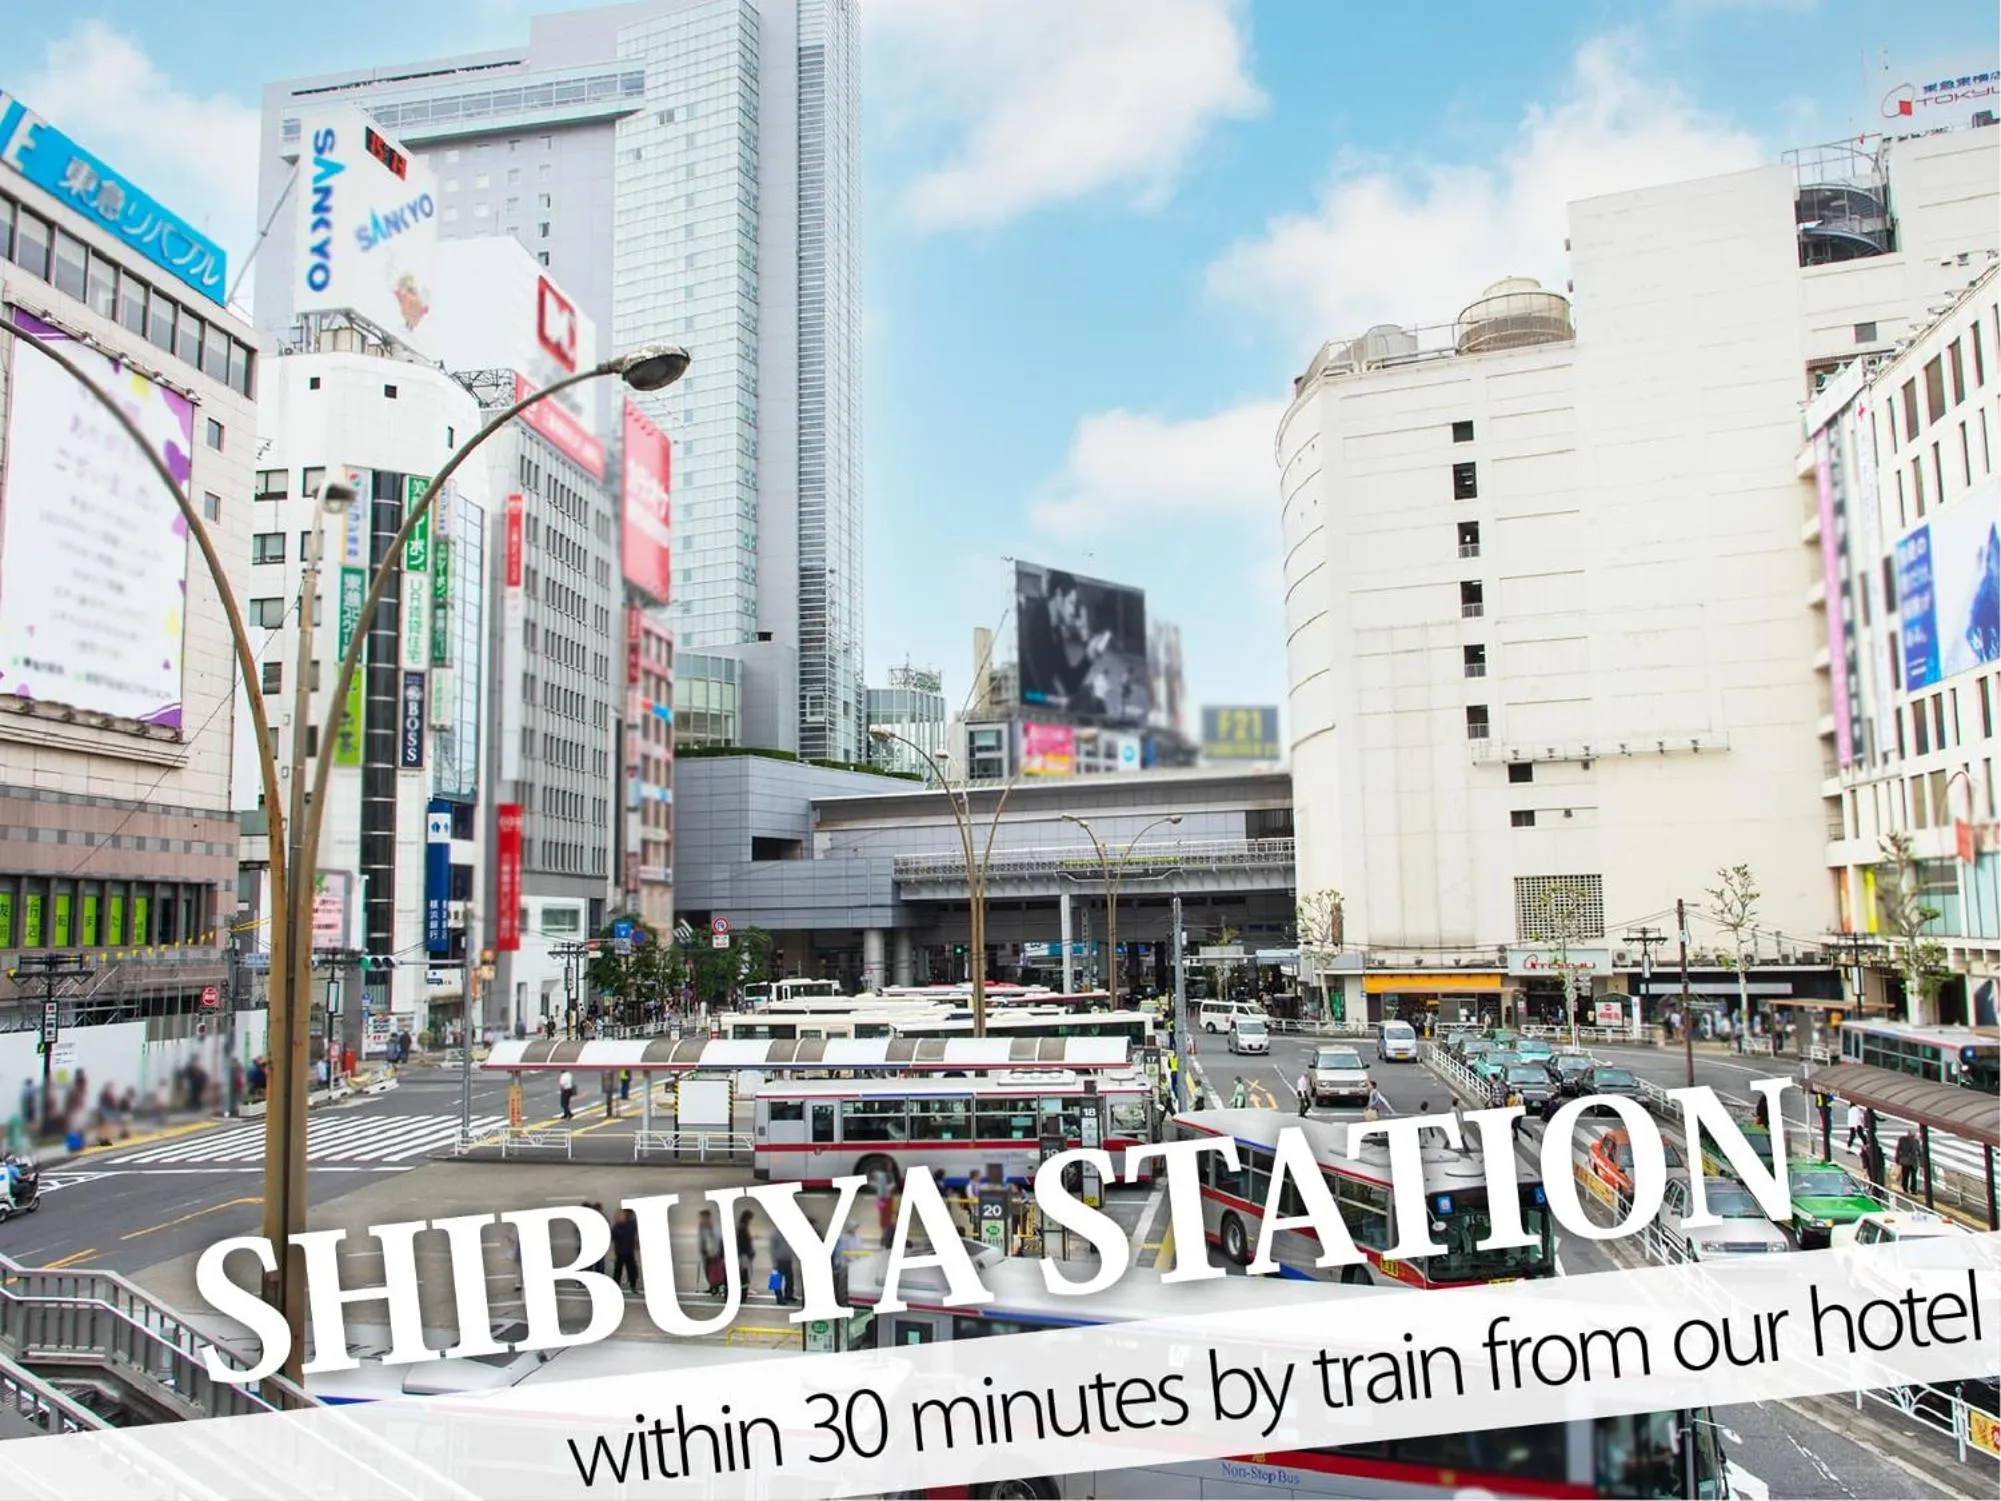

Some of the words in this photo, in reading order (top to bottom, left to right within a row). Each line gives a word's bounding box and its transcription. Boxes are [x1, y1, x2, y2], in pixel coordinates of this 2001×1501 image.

[58, 155, 219, 287] 東急リバブル
[306, 127, 346, 292] SANKYO
[355, 192, 435, 253] SANKYO
[405, 701, 421, 762] BOSS
[1083, 1107, 1097, 1117] 18
[983, 1204, 1002, 1217] 20
[1220, 1462, 1276, 1484] Non-Step
[1278, 1471, 1300, 1485] Bus
